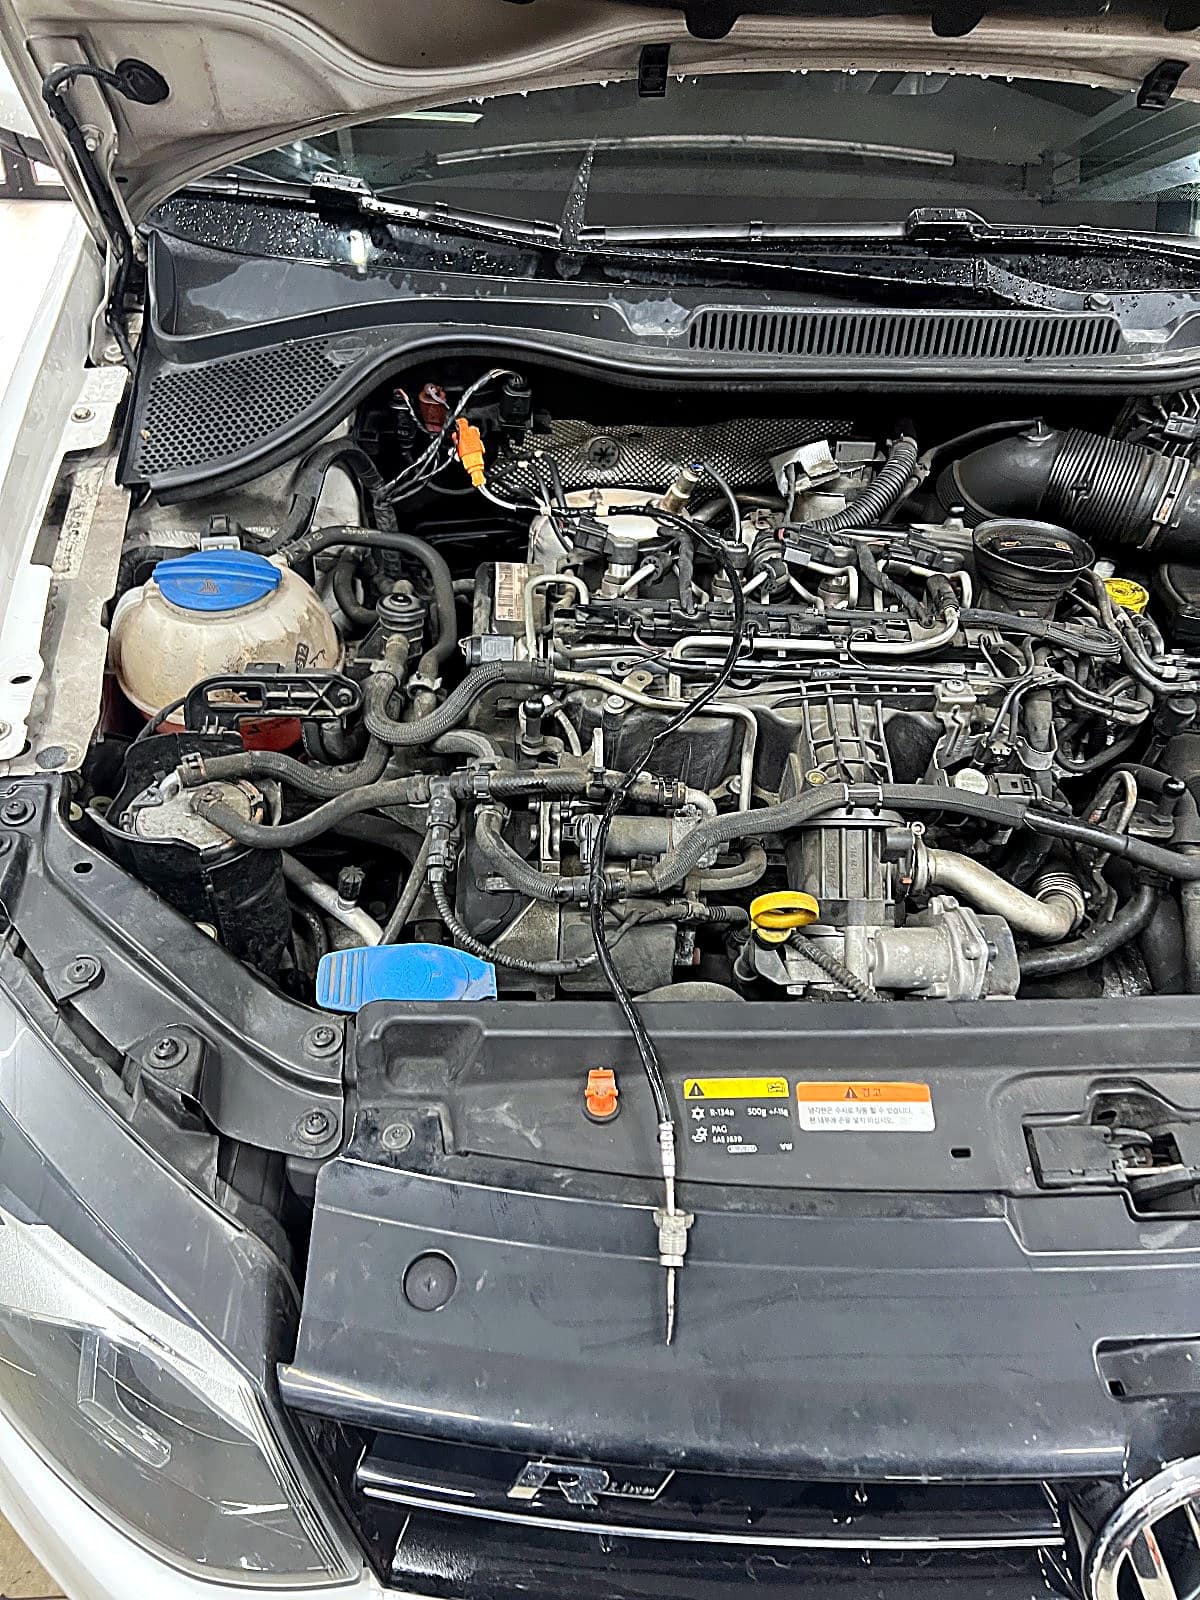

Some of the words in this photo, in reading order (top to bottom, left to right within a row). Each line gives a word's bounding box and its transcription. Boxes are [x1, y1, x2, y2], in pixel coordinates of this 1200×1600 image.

[709, 1108, 735, 1117] R-134a
[747, 1107, 767, 1118] 500g
[711, 1125, 727, 1133] PAG
